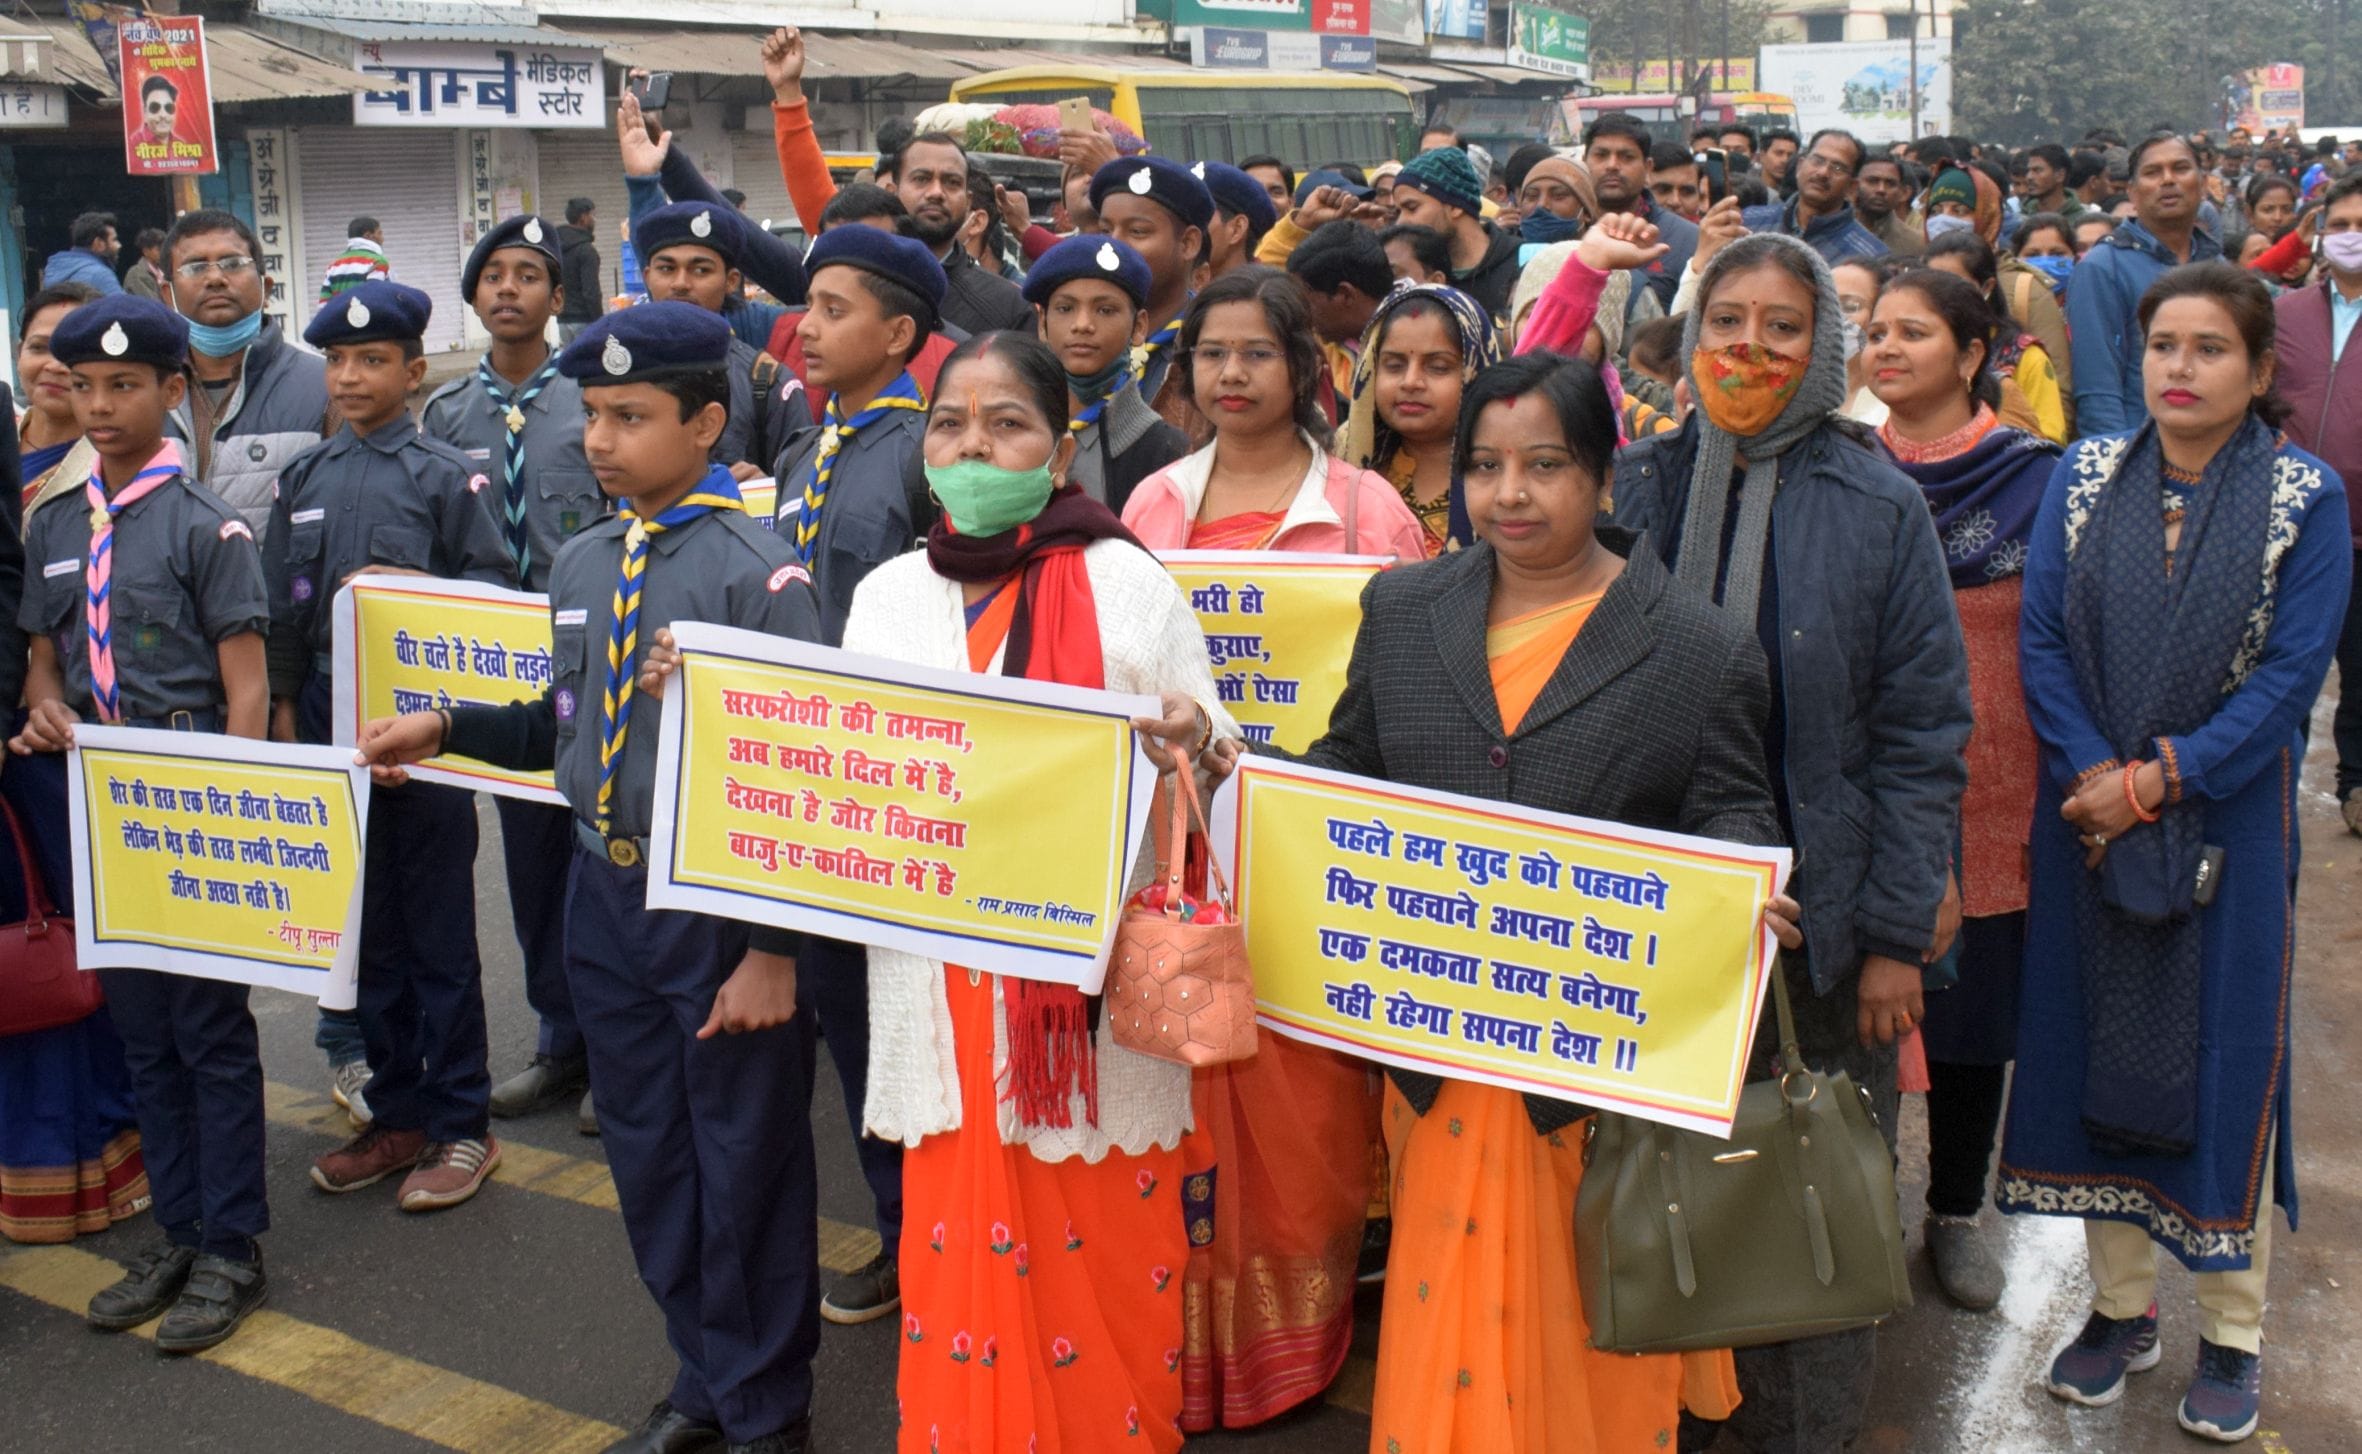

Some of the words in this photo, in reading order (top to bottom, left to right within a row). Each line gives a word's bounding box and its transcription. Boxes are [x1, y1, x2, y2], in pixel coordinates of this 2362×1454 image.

[166, 29, 195, 43] 2021
[526, 53, 594, 84] मेडिकल
[538, 87, 584, 115] स्टोर
[136, 141, 168, 159] नीरज
[1192, 584, 1231, 613] भरी
[1238, 584, 1264, 614] हो
[395, 630, 420, 666] वीर
[423, 636, 450, 670] चले
[453, 636, 466, 672] है
[472, 640, 507, 677] देखो
[1204, 635, 1270, 666] कुराए,
[1214, 673, 1246, 701] ओं
[1252, 673, 1299, 703] ऐसा
[722, 689, 831, 728] सरफरोशी
[841, 702, 876, 733] की
[885, 713, 973, 753] तमन्ना,
[729, 738, 769, 767] अब
[778, 743, 834, 779] हमारे
[843, 750, 895, 786] दिल
[905, 759, 930, 792] में
[937, 763, 963, 803] है,
[109, 777, 128, 804] शेर
[130, 779, 148, 808] की
[151, 787, 176, 810] तरह
[180, 789, 203, 813] एक
[206, 786, 232, 817] दिन
[236, 790, 270, 820] जीना
[274, 793, 312, 826] बेहतर
[313, 796, 329, 826] है
[726, 778, 794, 818] देखना
[802, 790, 822, 822] है
[830, 798, 877, 832] जोर
[884, 805, 966, 848] कितना
[122, 820, 160, 850] लेकिन
[164, 826, 184, 860] भेड़
[186, 829, 206, 858] की
[208, 836, 234, 861] तरह
[238, 837, 274, 866] लम्बी
[277, 839, 331, 871] जिन्दगी
[903, 859, 930, 892] में
[936, 864, 957, 896] है
[1327, 819, 1394, 857] पहले
[1403, 833, 1446, 867] हम
[1455, 842, 1510, 885] खुद
[1519, 852, 1562, 889] को
[1571, 865, 1669, 910] पहचाने
[169, 870, 201, 900] जीना
[206, 880, 240, 905] अच्छा
[977, 897, 1002, 914] राम
[1003, 900, 1042, 920] प्रसाद
[1326, 868, 1378, 909] फिर
[1386, 885, 1479, 930] पहचाने
[1489, 906, 1575, 948] अपना
[1583, 917, 1634, 960] देश
[280, 921, 304, 950] टीपू
[308, 929, 341, 951] सुल्ता
[1319, 928, 1370, 962] एक
[1379, 938, 1481, 984] दमकता
[1491, 961, 1551, 998] सत्य
[1560, 973, 1648, 1024] बनेगा,
[1385, 991, 1453, 1035] रहेगा
[1462, 1010, 1542, 1052] सपना
[1552, 1020, 1602, 1064] देश
